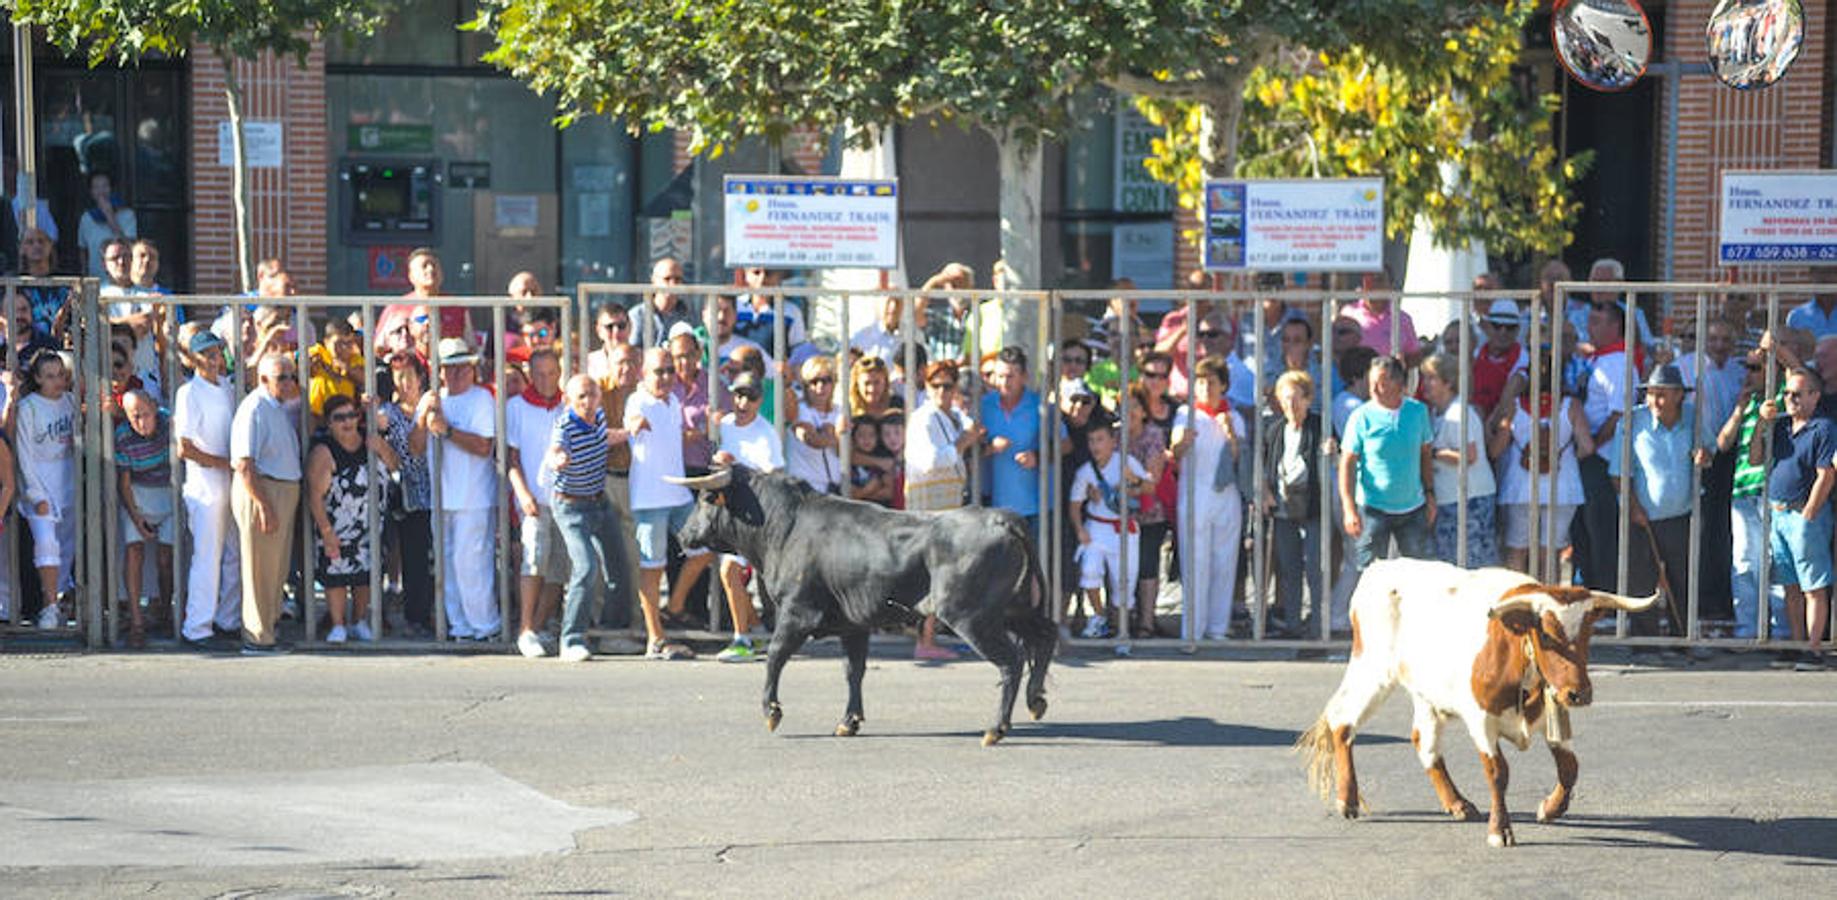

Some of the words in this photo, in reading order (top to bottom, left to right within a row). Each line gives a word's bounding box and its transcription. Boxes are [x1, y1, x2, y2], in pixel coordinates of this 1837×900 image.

[1729, 198, 1810, 209] FERNANDEZ
[1818, 198, 1837, 209] TR
[767, 211, 843, 221] FERNANDEZ
[1250, 209, 1329, 220] FERNANDEZ
[1335, 209, 1377, 220] TRADE
[749, 251, 767, 260] 677
[1727, 246, 1753, 259] 677
